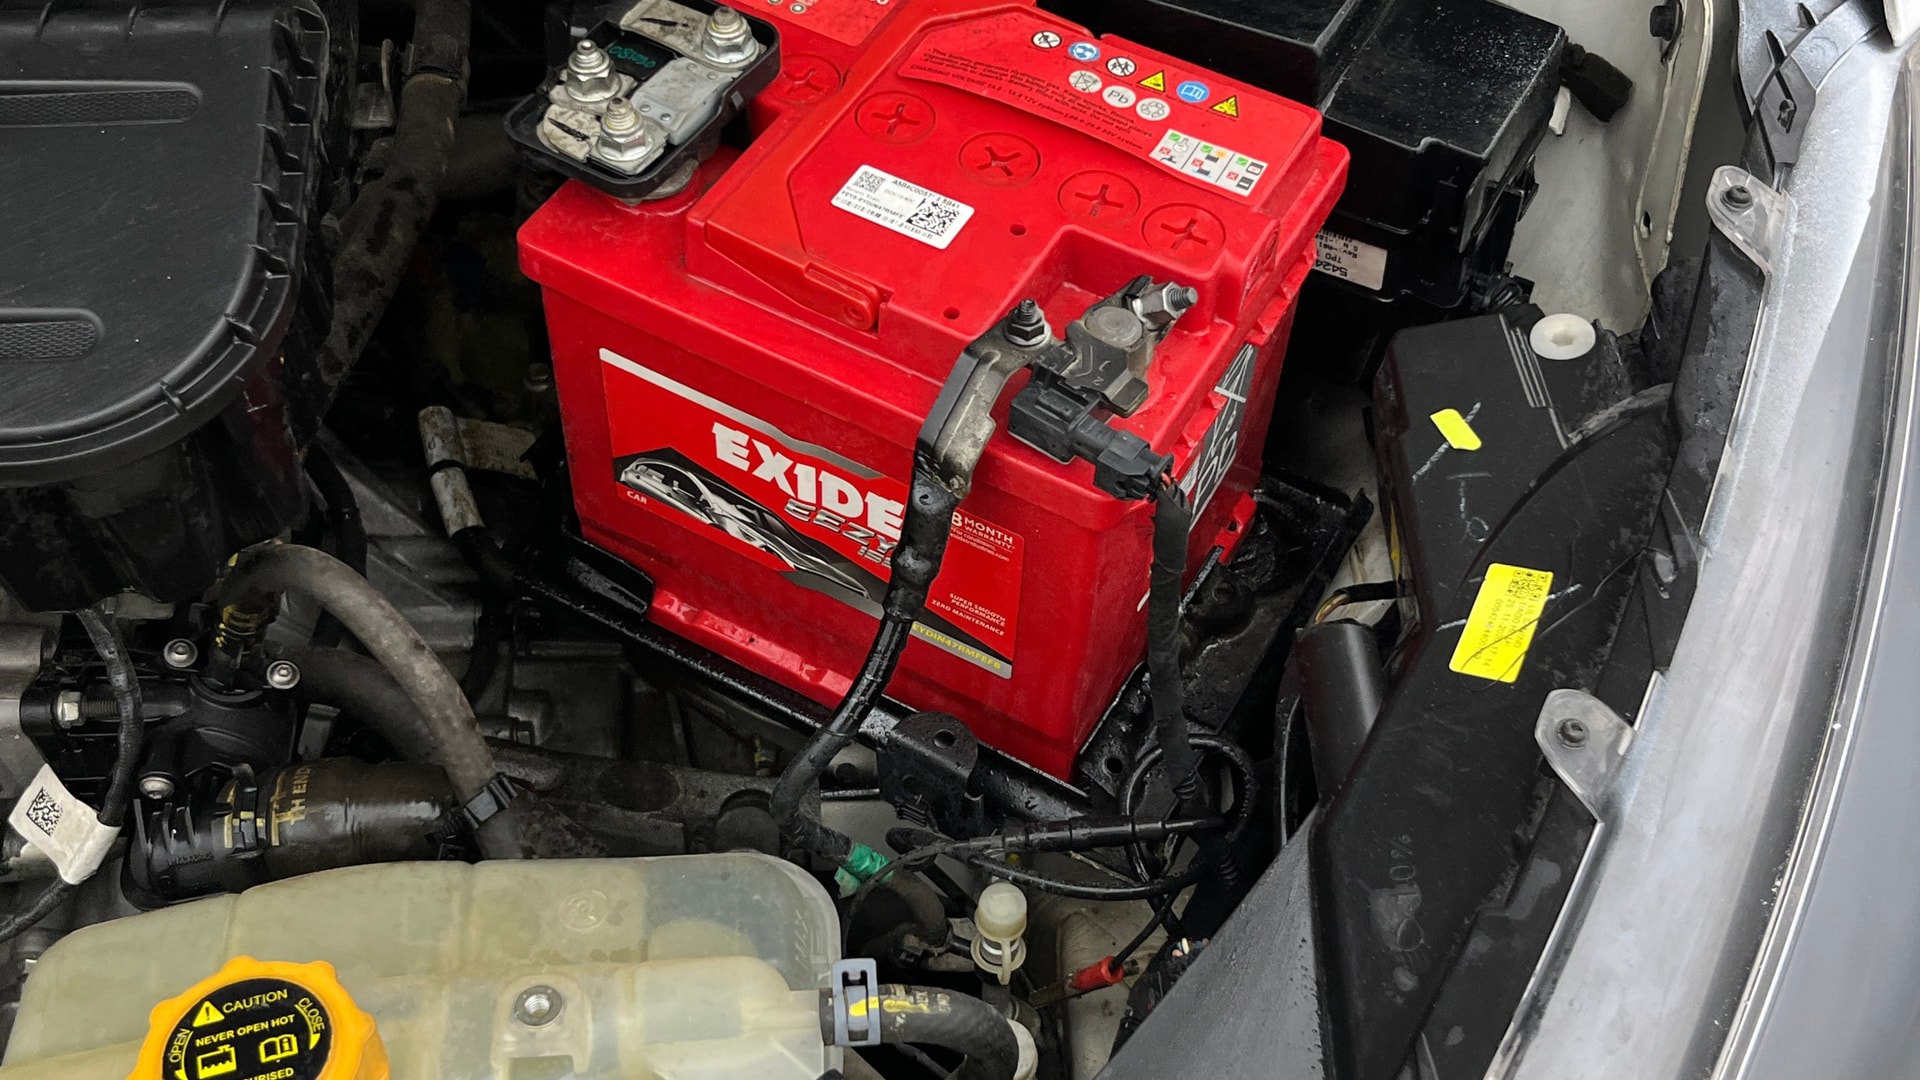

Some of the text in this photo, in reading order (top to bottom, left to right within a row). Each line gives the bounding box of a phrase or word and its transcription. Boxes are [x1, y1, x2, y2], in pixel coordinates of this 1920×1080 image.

[1107, 89, 1129, 105] Pb
[712, 421, 905, 542] EXIDE
[626, 490, 647, 505] CAR
[783, 497, 898, 555] EEZY
[964, 516, 1014, 545] MONTH
[931, 599, 1005, 637] ZERO MAINTENANCE
[949, 593, 1006, 622] SUPER SMOOTH
[951, 599, 1006, 628] PERFORMANCE
[222, 988, 288, 1014] CAUTION
[298, 996, 326, 1031] CLOSE
[168, 1027, 191, 1064] OPEN
[195, 1014, 296, 1048] NEVER OPEN HOT
